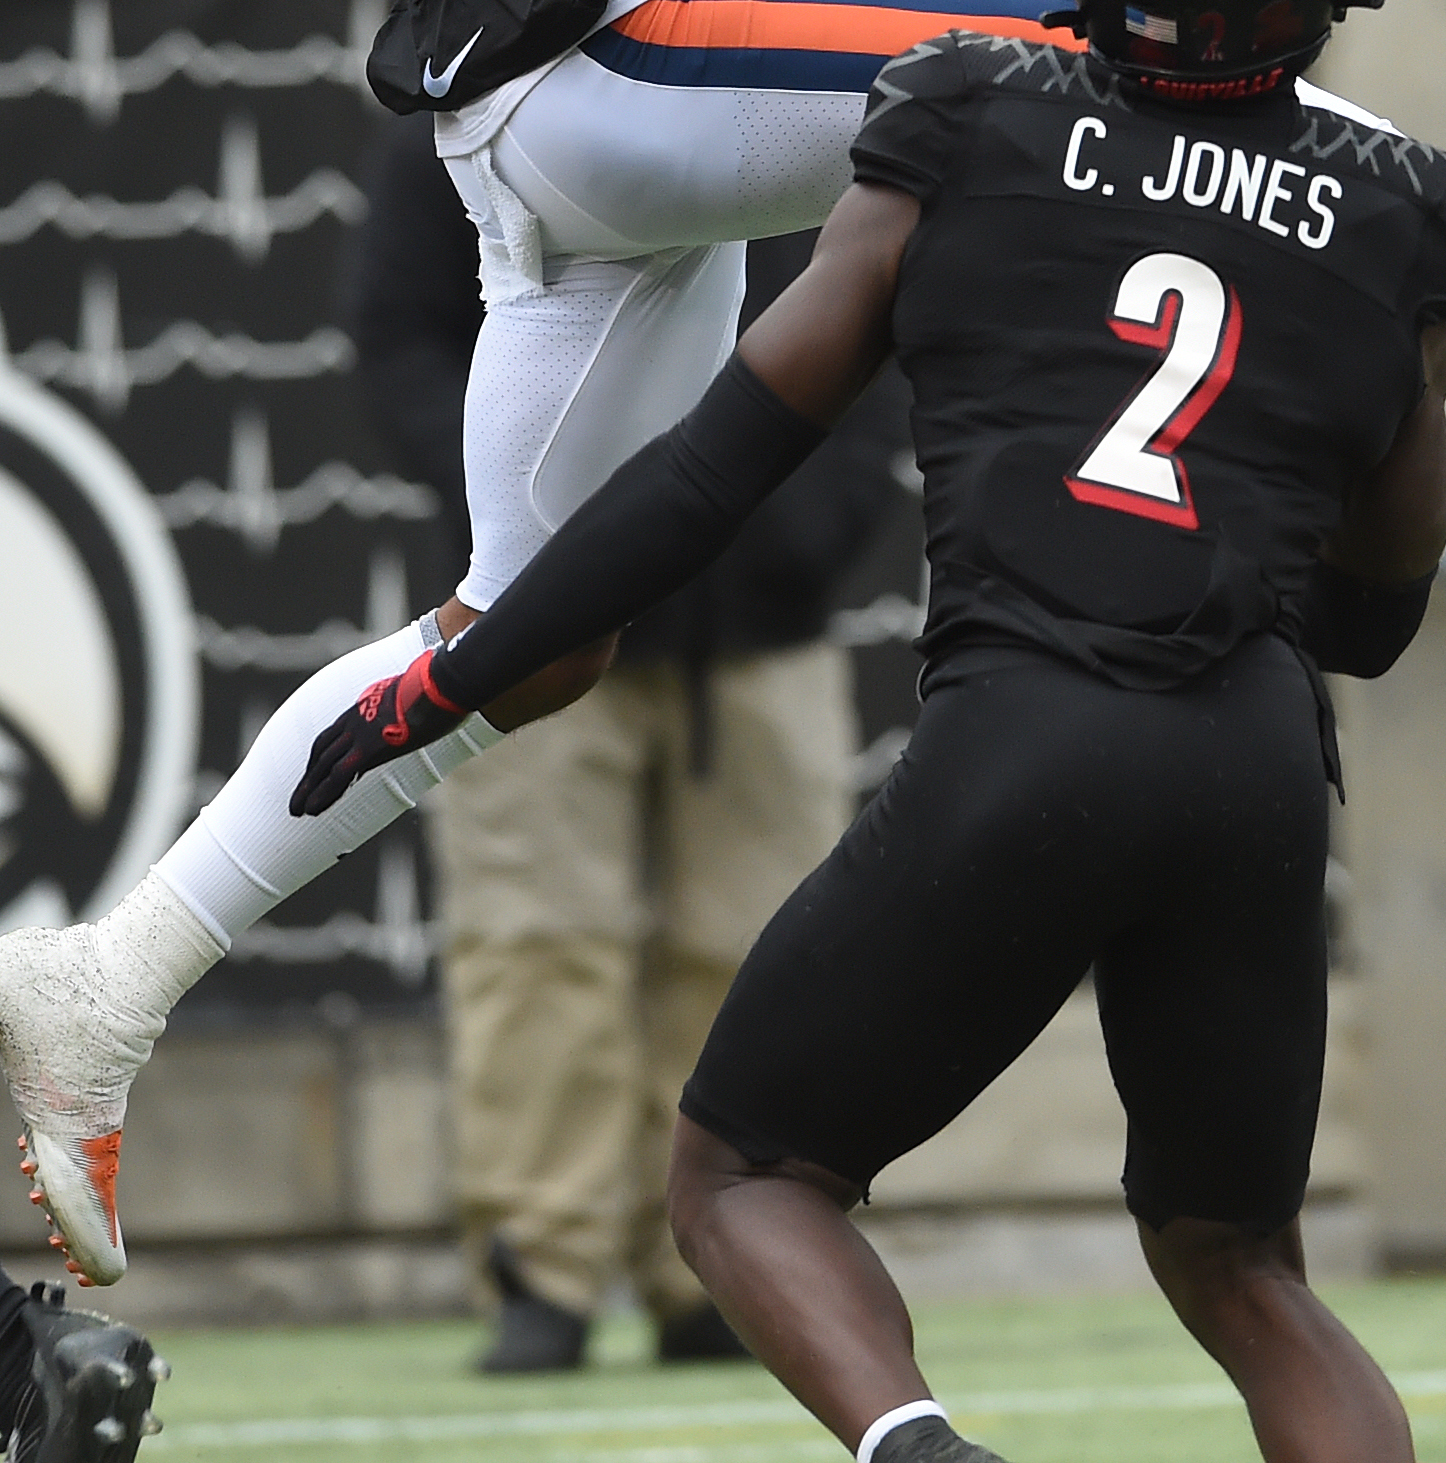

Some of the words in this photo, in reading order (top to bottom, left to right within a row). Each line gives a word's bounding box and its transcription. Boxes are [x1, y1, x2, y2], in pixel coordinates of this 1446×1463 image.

[1062, 116, 1115, 196] C.
[1141, 135, 1343, 250] JONES
[1061, 250, 1244, 531] 2
